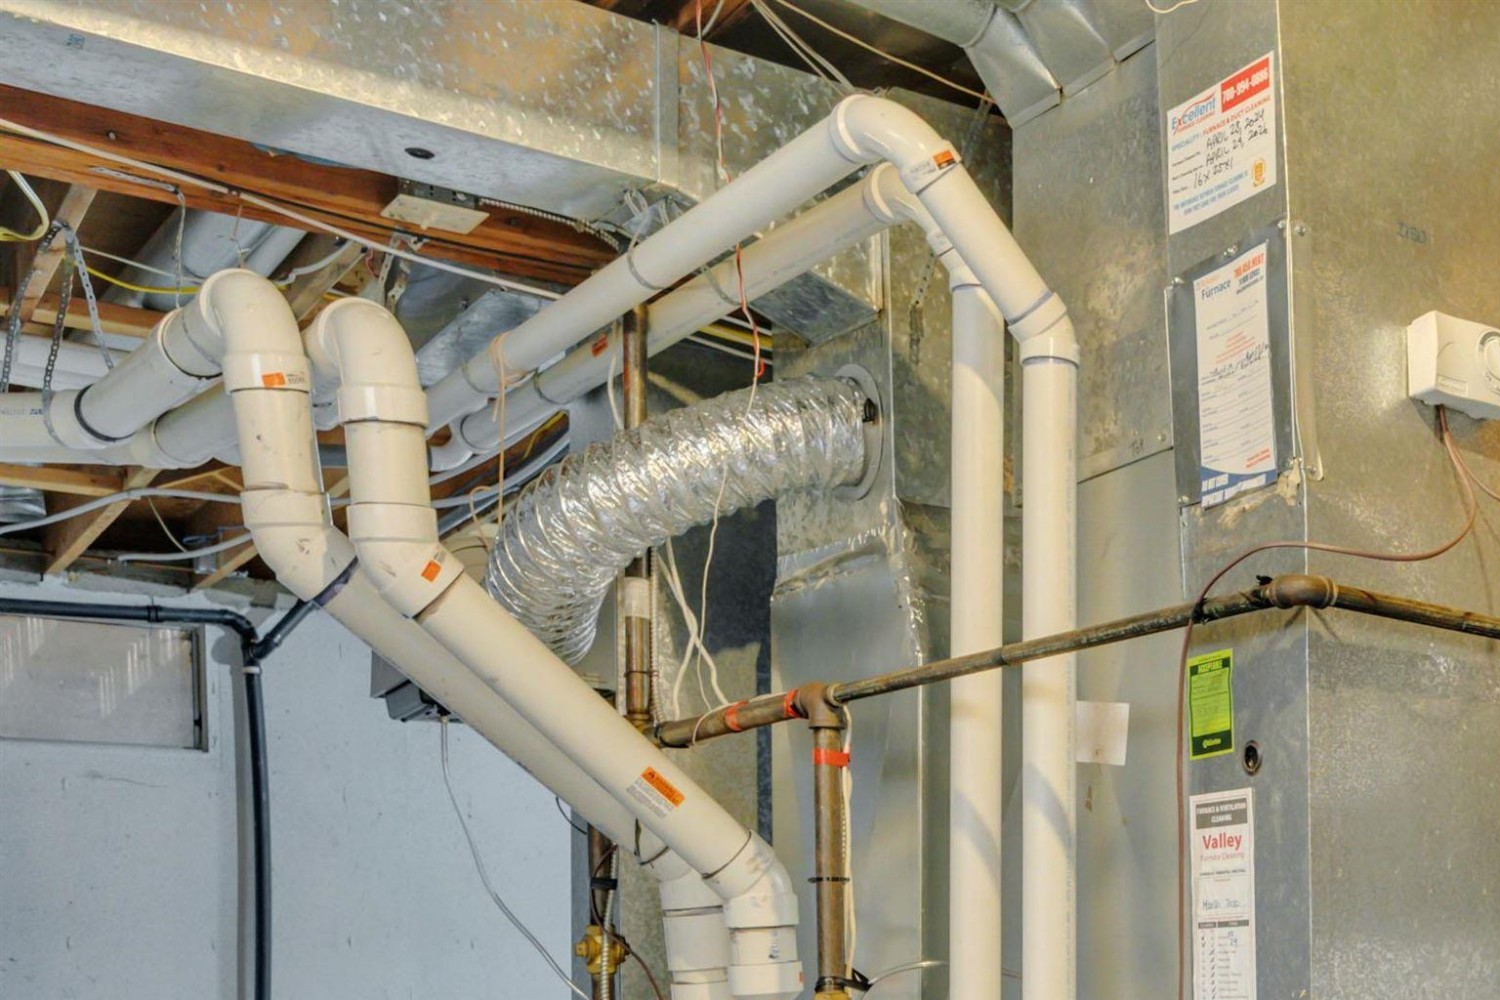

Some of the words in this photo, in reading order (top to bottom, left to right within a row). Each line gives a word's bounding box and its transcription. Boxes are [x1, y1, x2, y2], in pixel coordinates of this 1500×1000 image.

[1172, 97, 1216, 133] Excellent
[1201, 279, 1231, 300] Furnace
[1202, 832, 1242, 850] Valley
